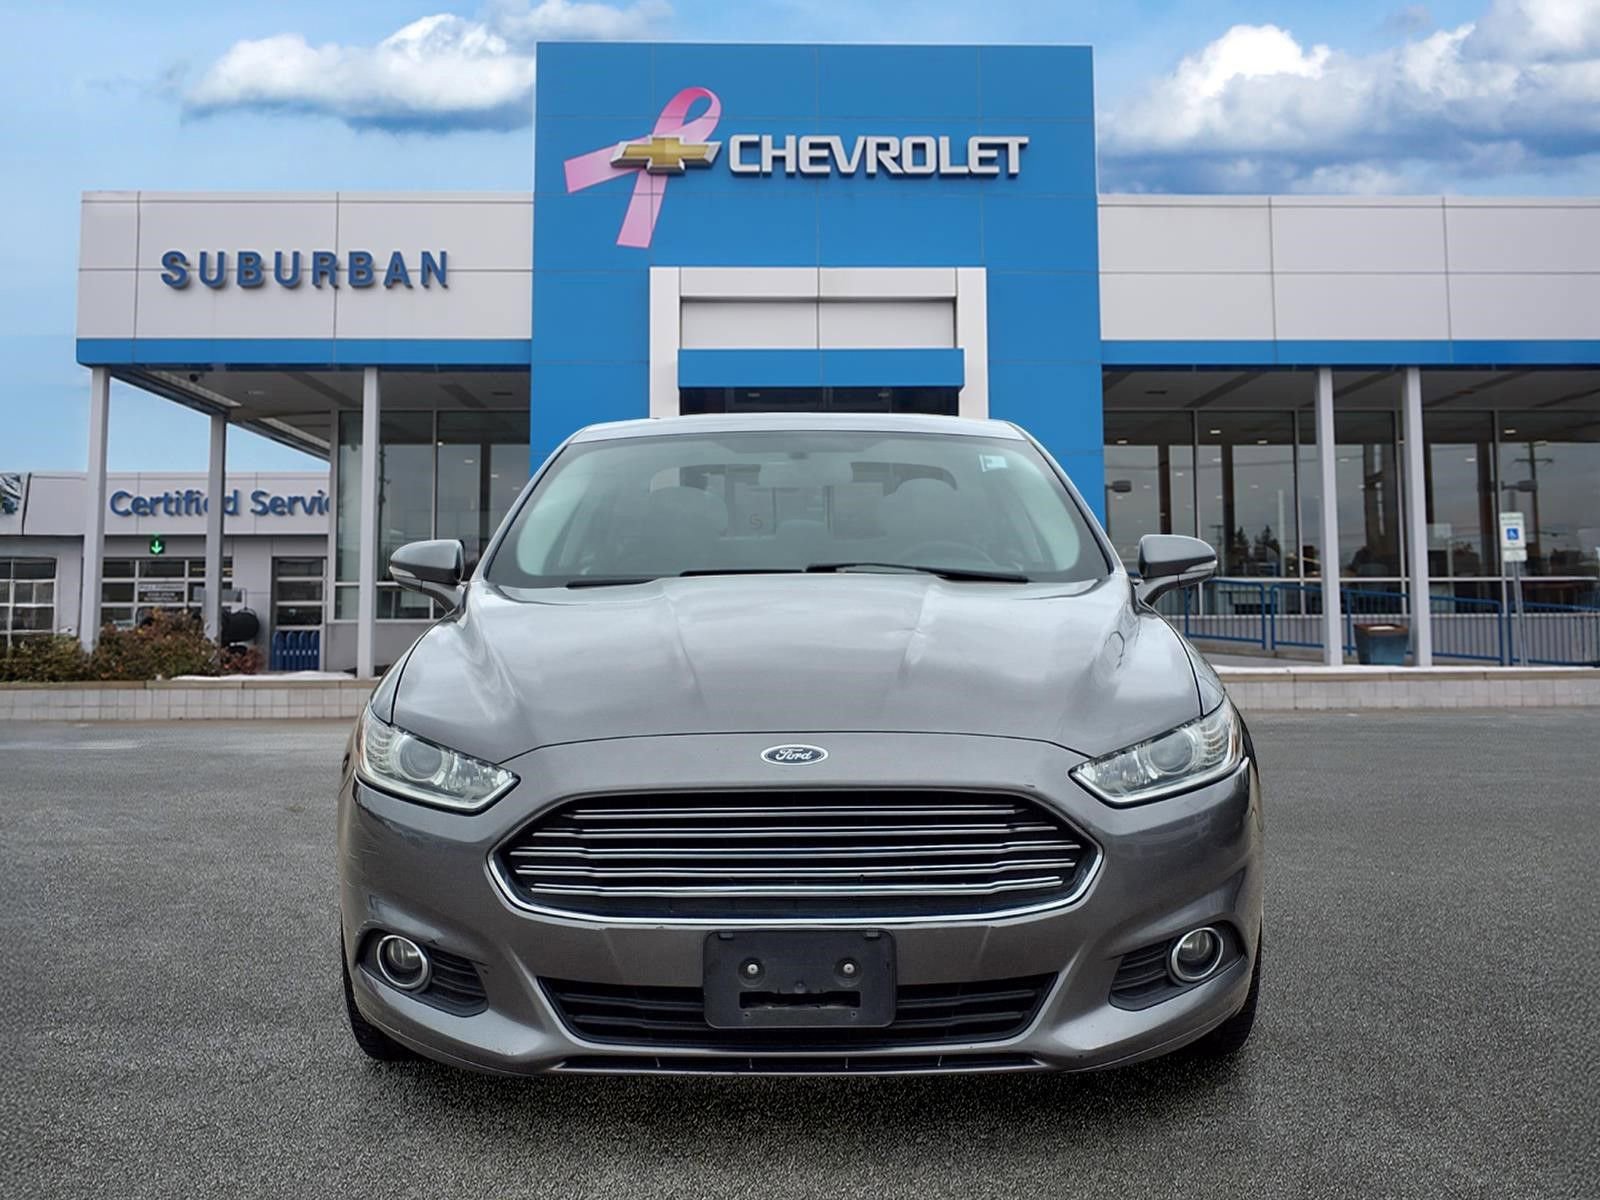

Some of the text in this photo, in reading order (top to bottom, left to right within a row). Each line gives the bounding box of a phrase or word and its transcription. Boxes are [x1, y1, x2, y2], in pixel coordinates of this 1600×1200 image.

[729, 134, 1029, 174] CHEVROLET
[161, 250, 448, 289] SUBURBAN
[110, 489, 240, 517] Certifid
[775, 748, 813, 760] Ford
